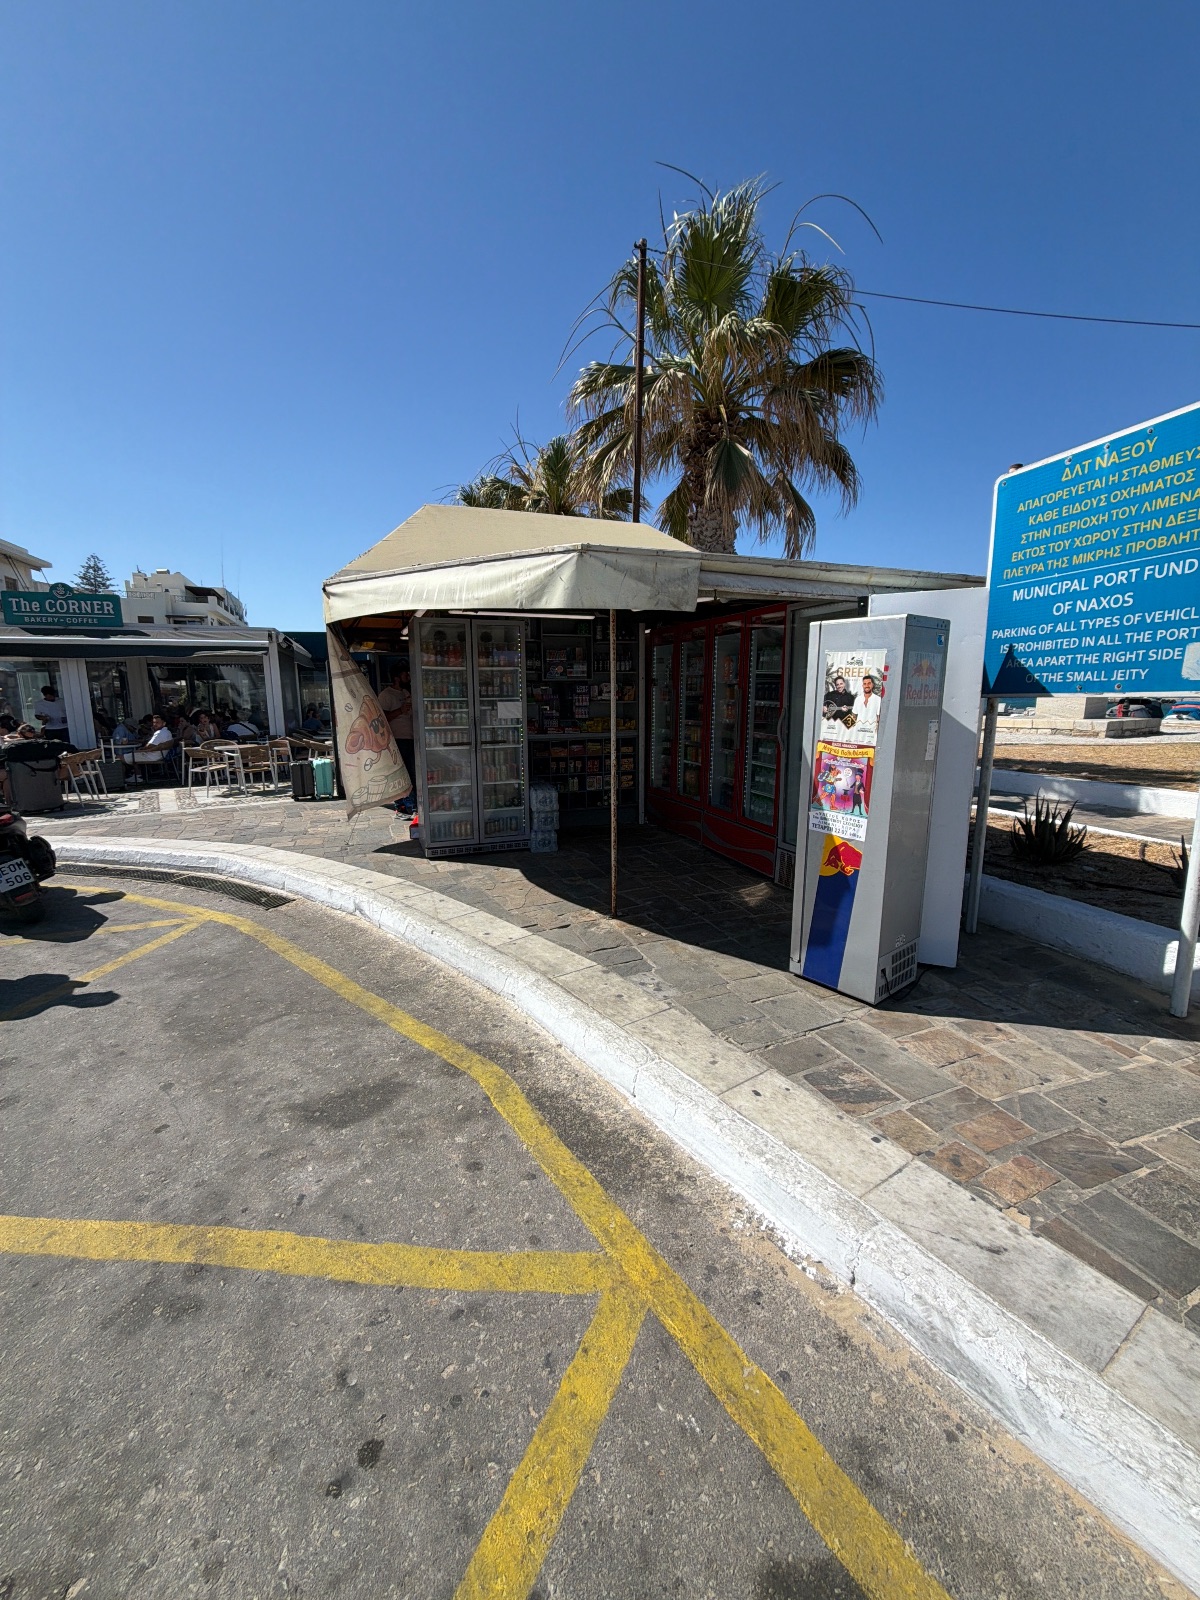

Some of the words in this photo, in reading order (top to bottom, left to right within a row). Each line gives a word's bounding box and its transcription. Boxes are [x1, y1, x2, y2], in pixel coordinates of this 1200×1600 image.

[1061, 458, 1092, 482] ΔΛΤ
[1095, 436, 1158, 470] ΝΑΞΟΥ
[1017, 476, 1106, 513] ΑΠΑΓΟΡΕΥΕΤΑΙ
[1108, 474, 1119, 486] Η
[1028, 508, 1060, 526] ΚΑΘΕ
[1062, 494, 1108, 518] ΕΙΔΟΥΣ
[1110, 468, 1197, 503] ΟΧΗΜΑΤΟΣ
[1020, 528, 1051, 545] ΣΤΗΝ
[1053, 512, 1109, 536] ΠΕΡΙΟΧΗ
[1111, 504, 1139, 522] ΤΟΥ
[1003, 564, 1045, 580] ΠΛΕΥΡΑ
[1047, 556, 1069, 571] ΤΗΣ
[1072, 545, 1123, 565] ΜΙΚΡΗΣ
[1126, 528, 1200, 555] ΠΡΟΒΛΗΤ
[1011, 544, 1047, 563] ΕΚΤΟΣ
[1049, 538, 1073, 554] ΤΟΥ
[1073, 528, 1120, 548] ΧΩΡΟΥ
[1122, 517, 1163, 537] ΣΤΗΝ
[1012, 578, 1089, 601] MUNICIPAL
[1093, 567, 1140, 588] PORT
[1143, 559, 1199, 580] FUND
[8, 598, 40, 612] The
[45, 599, 115, 614] CORNER
[1052, 601, 1073, 616] OF
[1075, 592, 1134, 612] NAXOS
[991, 625, 1036, 640] PARKING
[1038, 623, 1054, 635] OF
[1055, 619, 1077, 633] ALL
[1080, 615, 1120, 630] TYPES
[1123, 612, 1142, 626] OF
[1144, 607, 1200, 624] VEHICL
[1000, 643, 1010, 653] IS
[1012, 638, 1079, 654] PROHIBITED
[1081, 636, 1095, 647] IN
[1097, 633, 1122, 648] ALL
[1125, 631, 1153, 643] THE
[1156, 626, 1200, 641] PORT
[837, 667, 871, 678] GREEK
[1006, 657, 1034, 669] AREA
[1035, 654, 1075, 667] APART
[1076, 654, 1100, 665] THE
[1102, 649, 1146, 663] RIGHT
[1148, 647, 1183, 661] SIDE
[1025, 672, 1040, 683] OF
[1040, 672, 1064, 683] THE
[1066, 670, 1109, 682] SMALL
[1111, 668, 1150, 681] JEITY
[906, 683, 923, 700] Red
[5, 872, 31, 887] 506
